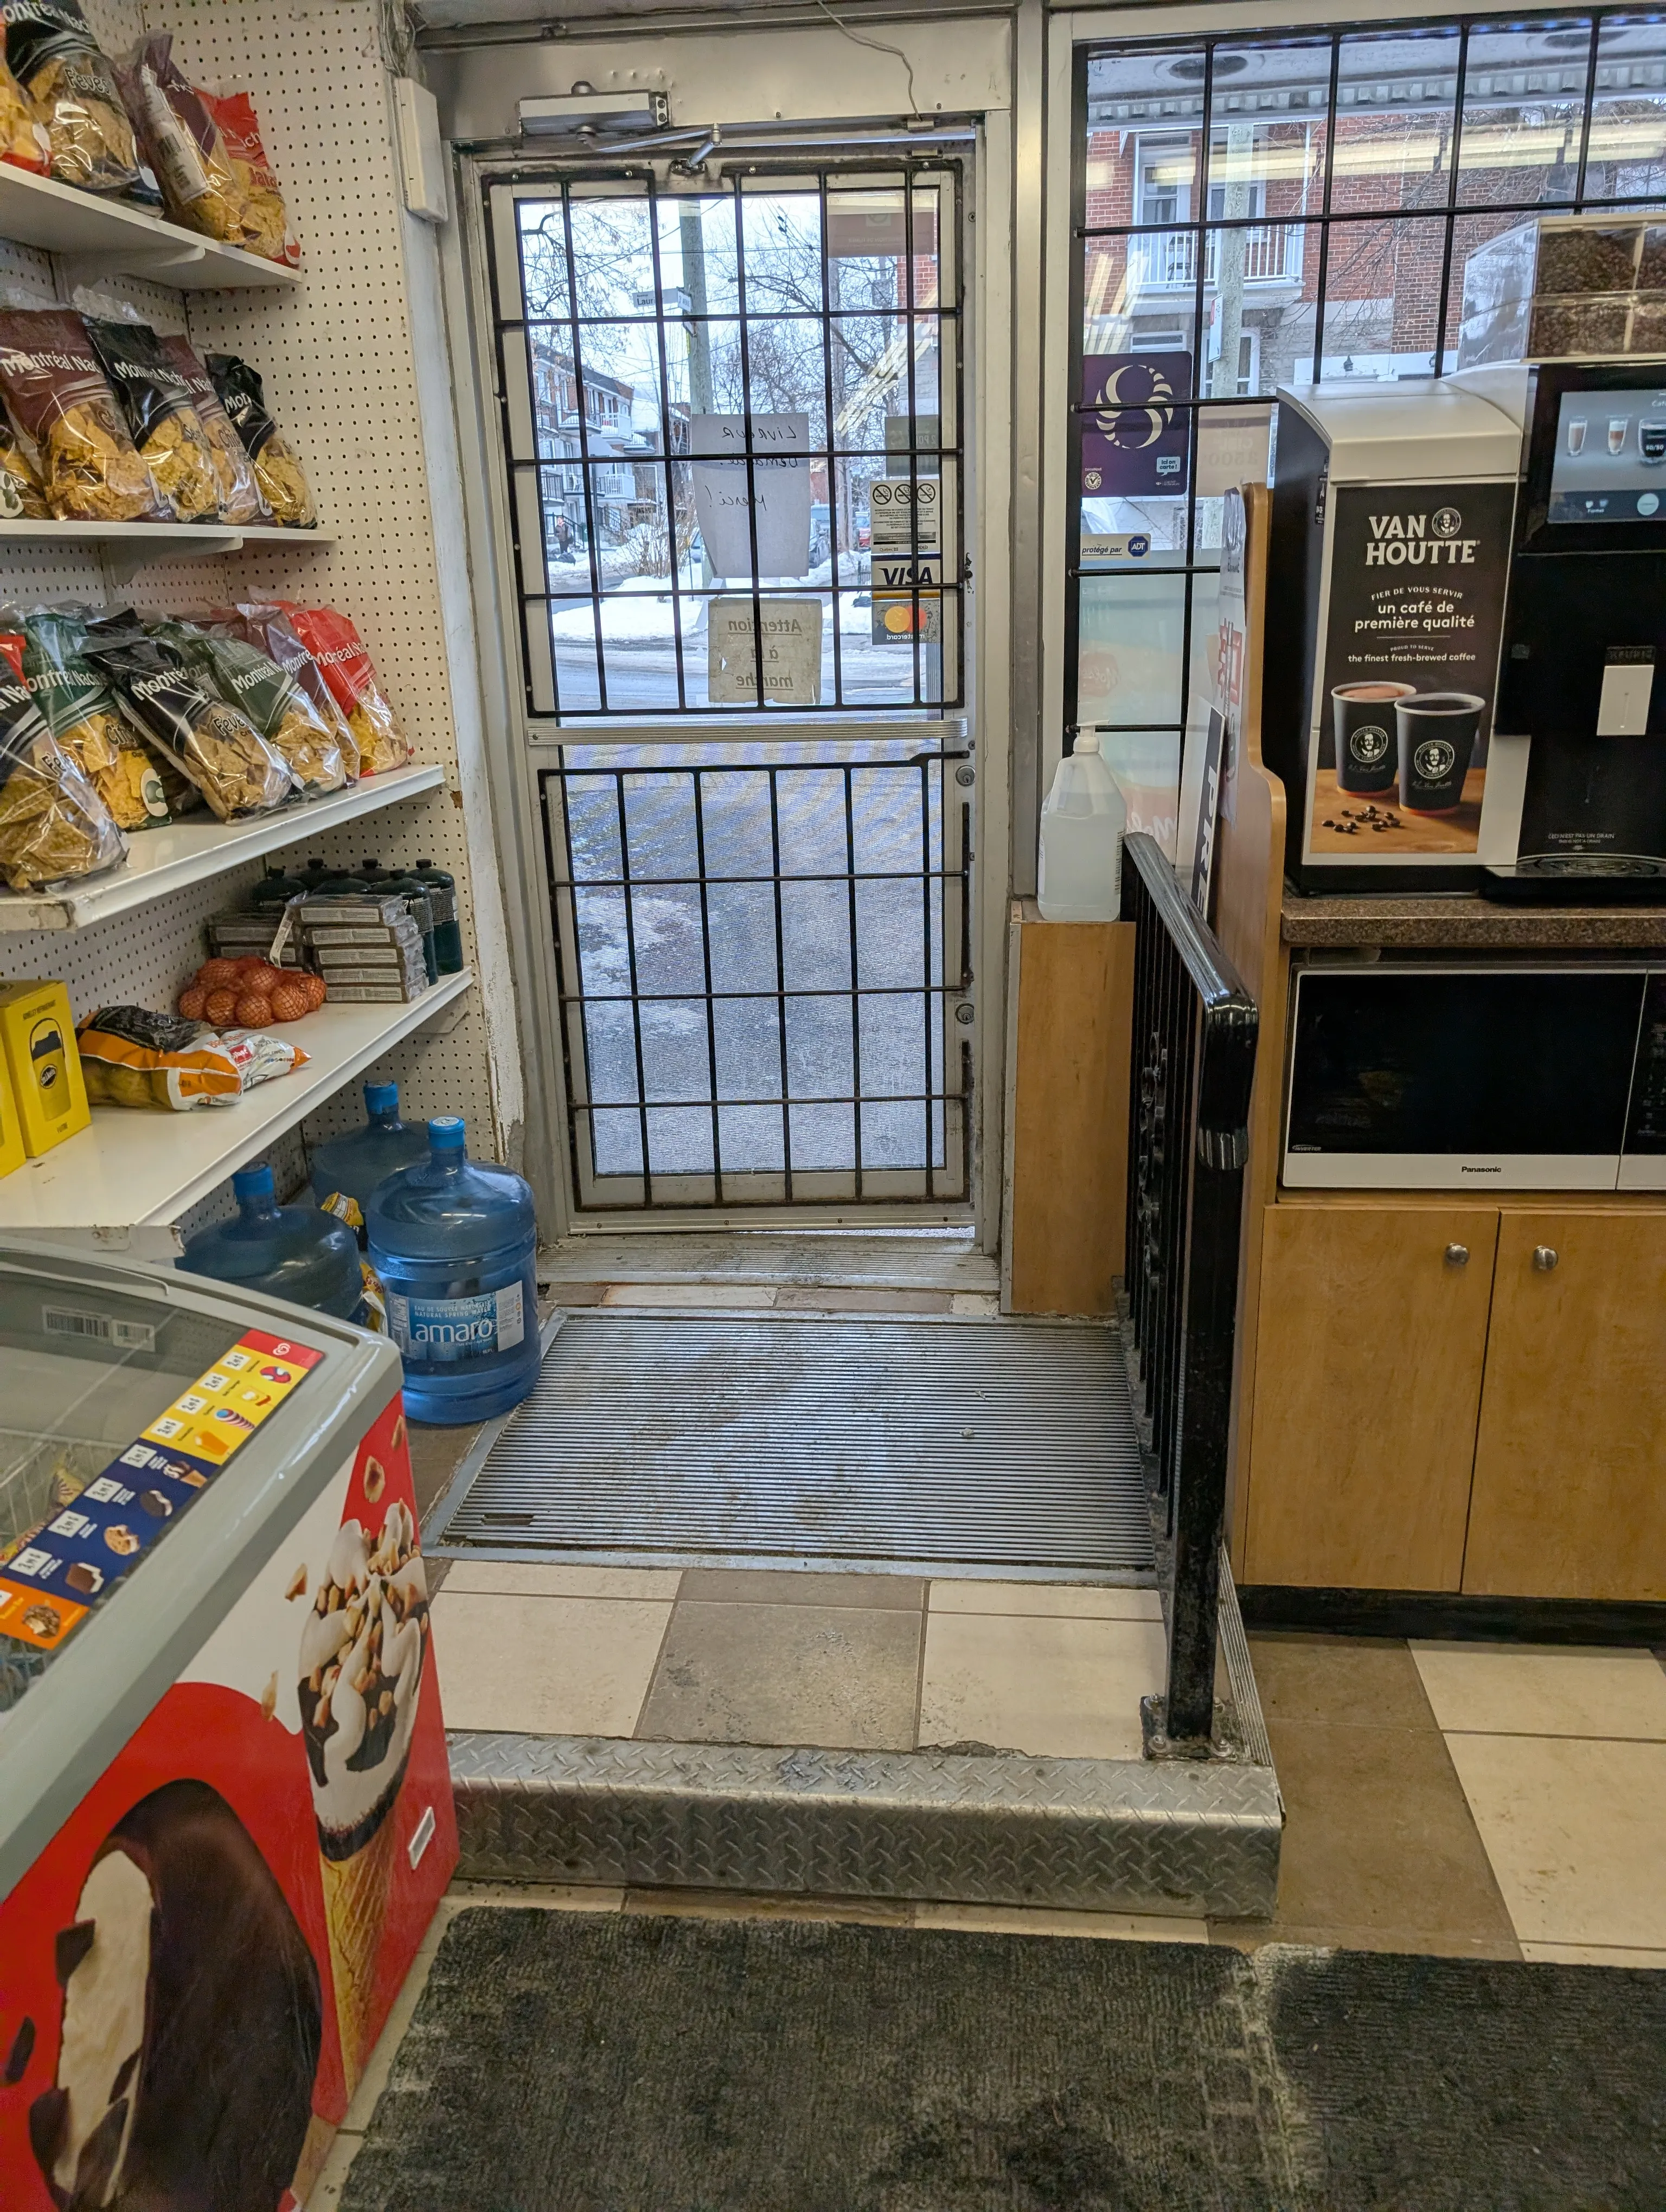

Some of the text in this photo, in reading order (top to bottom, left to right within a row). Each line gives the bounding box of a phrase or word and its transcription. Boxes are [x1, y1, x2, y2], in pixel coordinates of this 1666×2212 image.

[1369, 515, 1427, 539] VAN
[1082, 545, 1108, 554] protégé
[1366, 541, 1476, 565] HOUTTE
[1371, 590, 1391, 601] FIER
[1433, 587, 1463, 600] SERVIR
[1378, 601, 1454, 614] un café de
[1355, 615, 1475, 633] première qualité
[1364, 654, 1389, 662] finest
[1391, 653, 1447, 661] fresh-brewed
[1449, 653, 1476, 661] coffee
